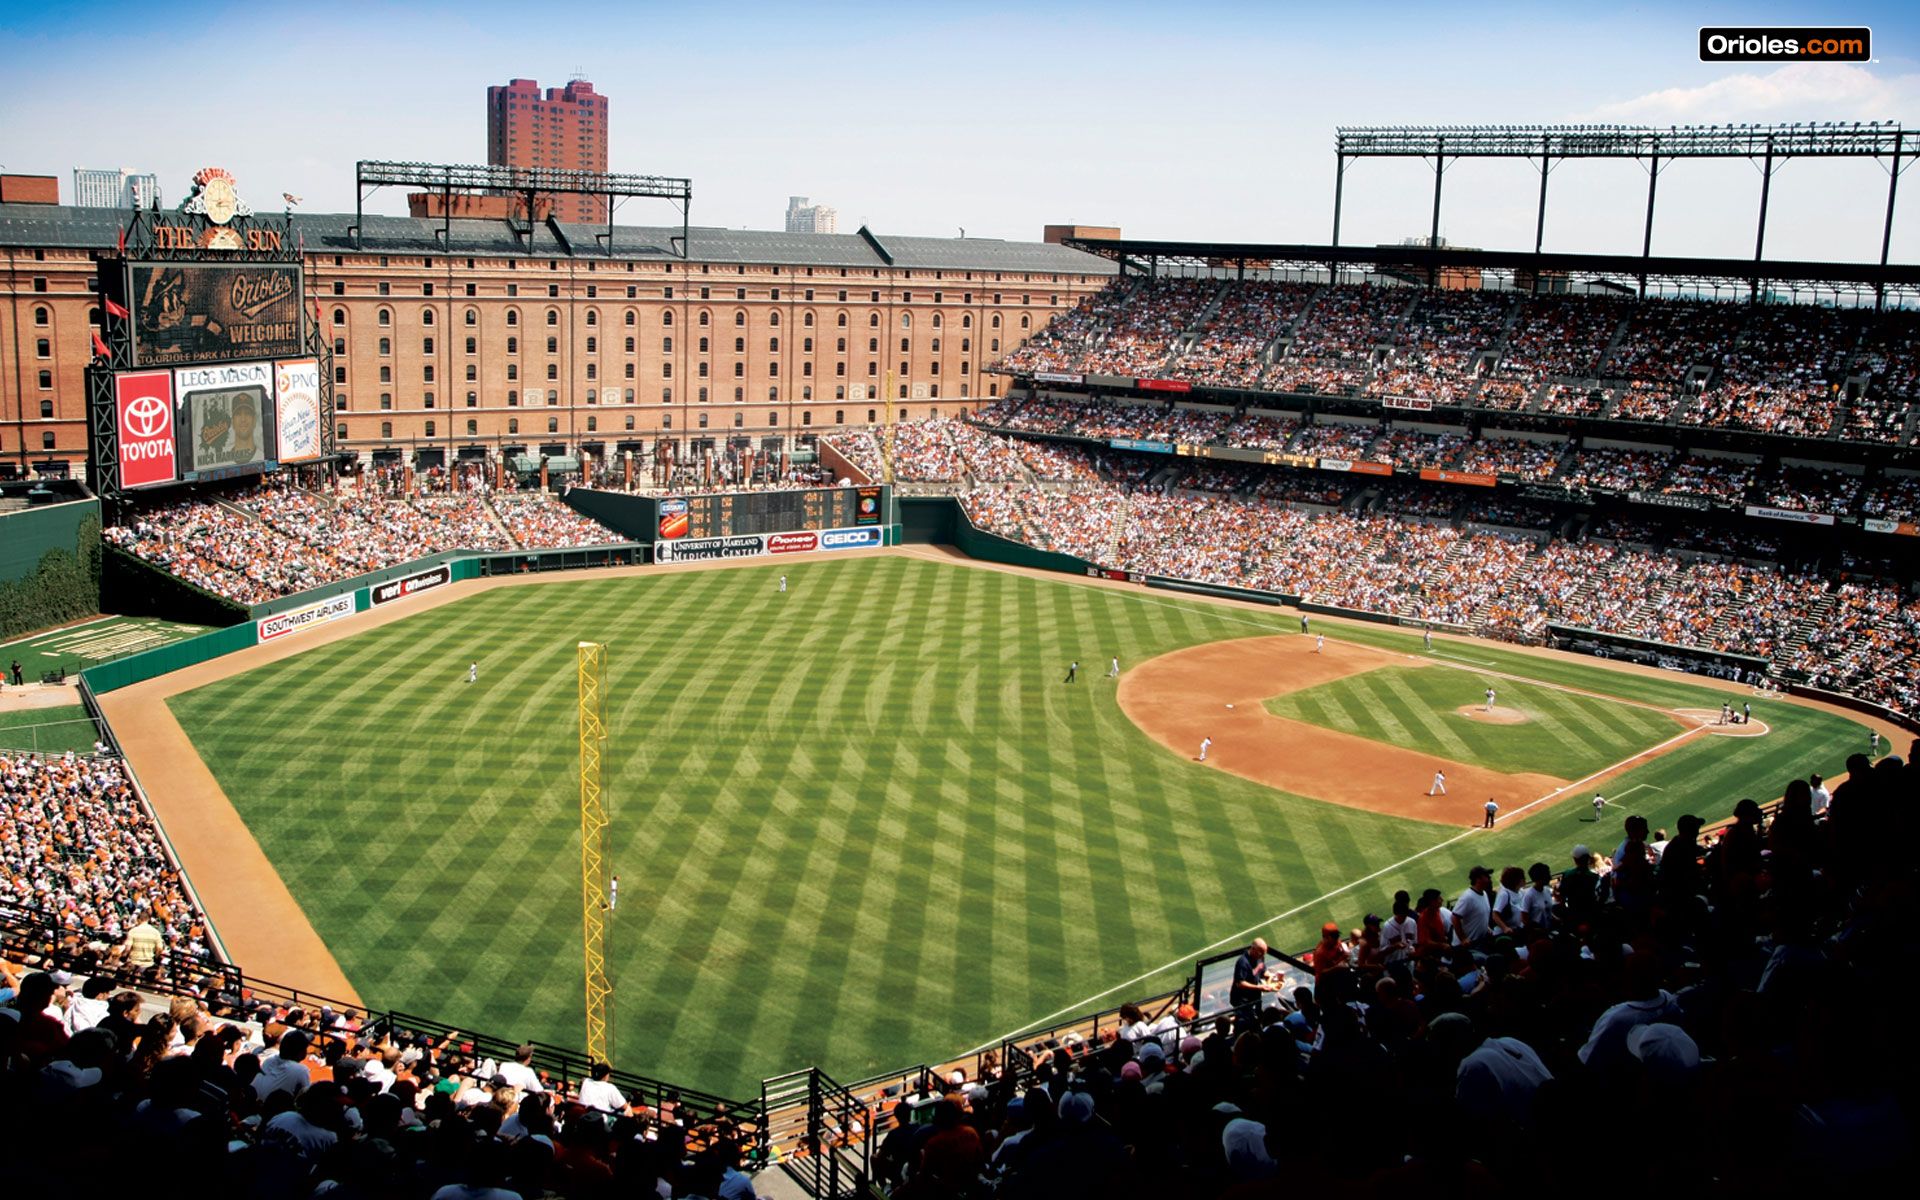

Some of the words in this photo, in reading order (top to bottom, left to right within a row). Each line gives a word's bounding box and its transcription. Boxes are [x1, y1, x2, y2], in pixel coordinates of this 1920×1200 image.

[154, 227, 195, 249] THE
[248, 230, 281, 251] SUN
[232, 270, 294, 312] Orioles
[229, 323, 297, 344] WELCOME!
[155, 353, 190, 364] ORIOLE
[193, 351, 218, 361] PARK
[221, 350, 232, 359] AT
[234, 346, 270, 358] CAMDEN
[181, 371, 216, 387] LEGG
[220, 366, 268, 384] MASON
[292, 372, 317, 388] PNC
[121, 439, 174, 462] TOYOTA
[1644, 498, 1700, 509] LEGENDS
[1758, 509, 1772, 517] Bank
[1779, 512, 1804, 520] America
[673, 541, 711, 551] UNIVERSITY
[722, 538, 759, 548] MARYLAND
[772, 535, 815, 544] Pioneer
[823, 532, 870, 545] GEICO
[673, 551, 718, 561] MEDICAL
[721, 548, 763, 558] CENTER
[266, 610, 316, 635] SOUTHWEST
[316, 600, 349, 618] AIRLINES
